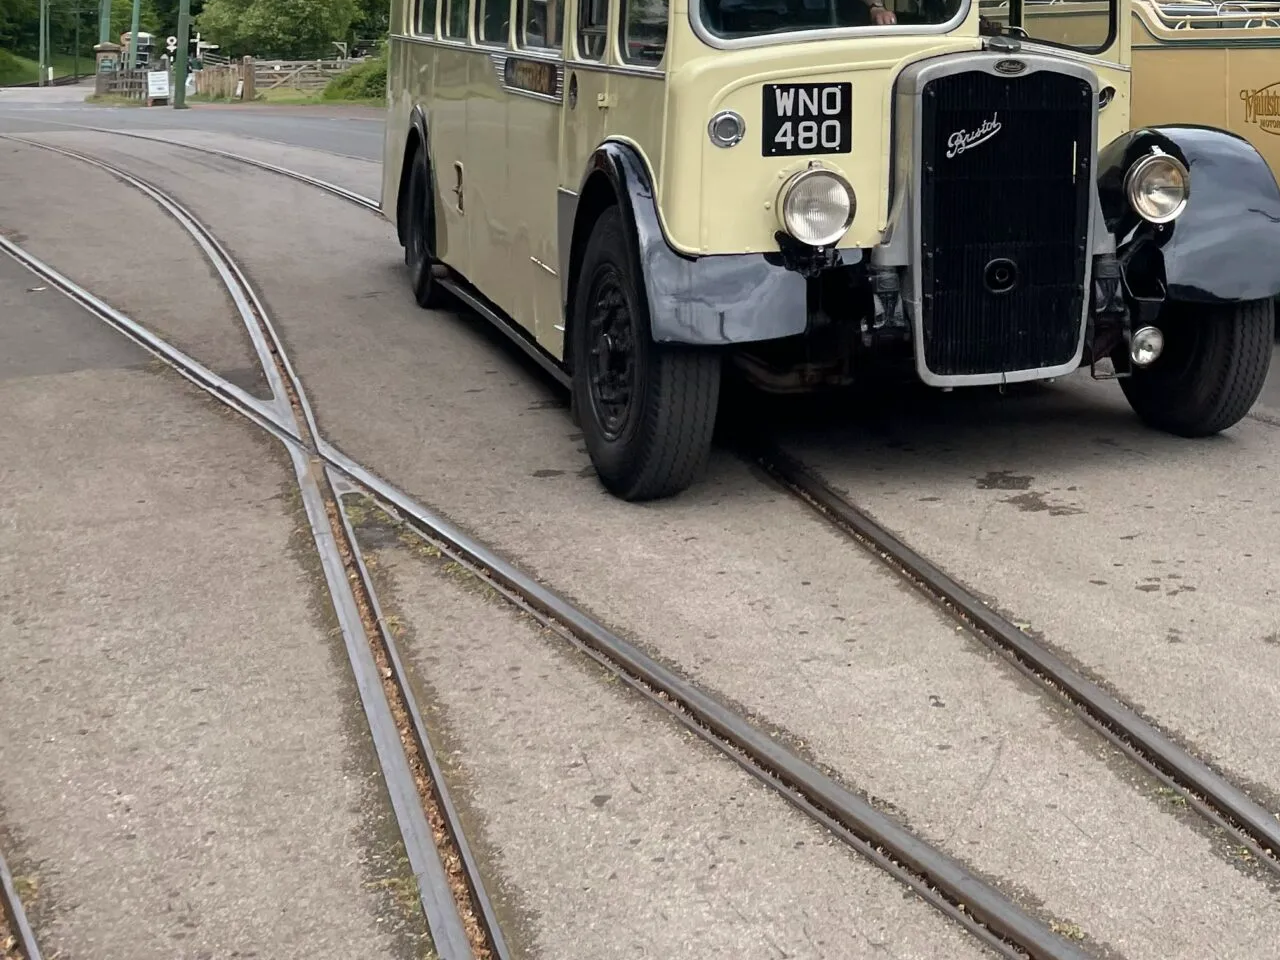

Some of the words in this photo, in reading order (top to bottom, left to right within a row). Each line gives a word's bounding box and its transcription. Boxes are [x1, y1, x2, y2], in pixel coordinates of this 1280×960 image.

[775, 87, 841, 116] WNO
[774, 120, 841, 149] 480
[946, 112, 1001, 158] Bristol
[1260, 119, 1280, 128] MOTOR
